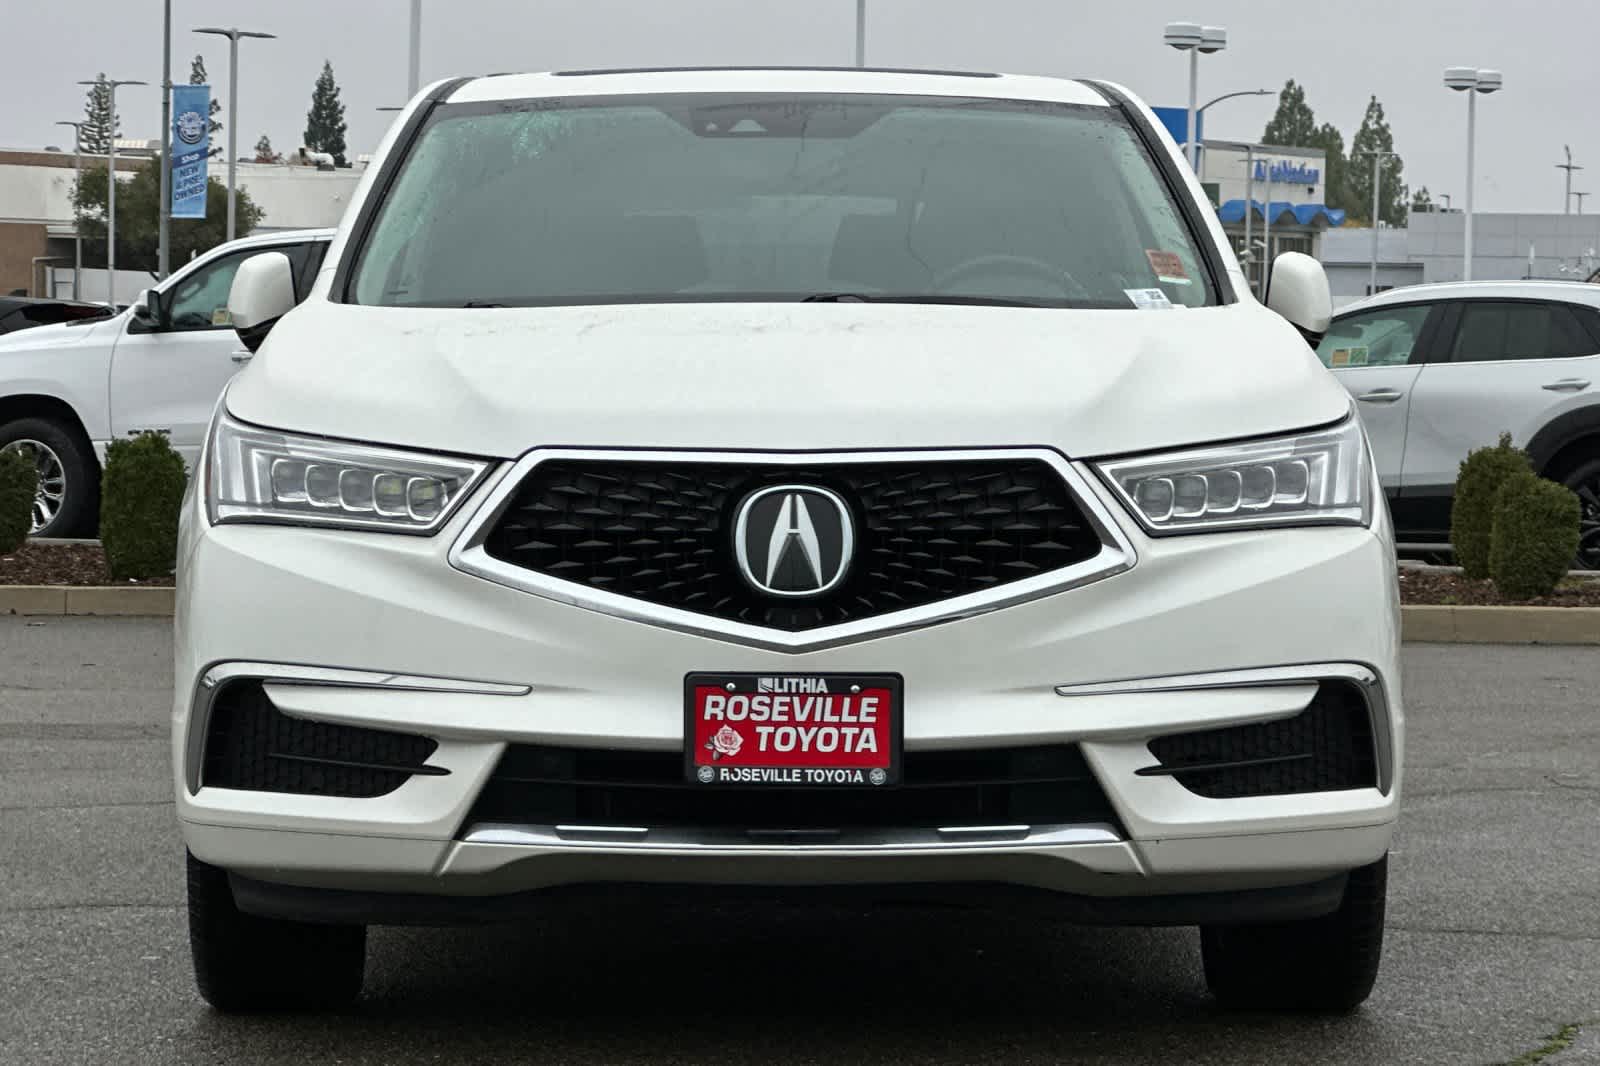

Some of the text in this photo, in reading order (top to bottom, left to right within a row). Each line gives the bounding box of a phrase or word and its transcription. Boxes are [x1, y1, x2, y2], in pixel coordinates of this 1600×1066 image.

[180, 166, 199, 177] NEW
[1255, 160, 1319, 184] AtoNation
[175, 183, 205, 200] OWNED
[775, 678, 828, 693] LITHIA
[704, 695, 879, 723] ROSEVILLE
[755, 726, 878, 753] TOYOTA
[720, 768, 801, 783] ROSEVILLE
[805, 769, 864, 783] TOYOTA
